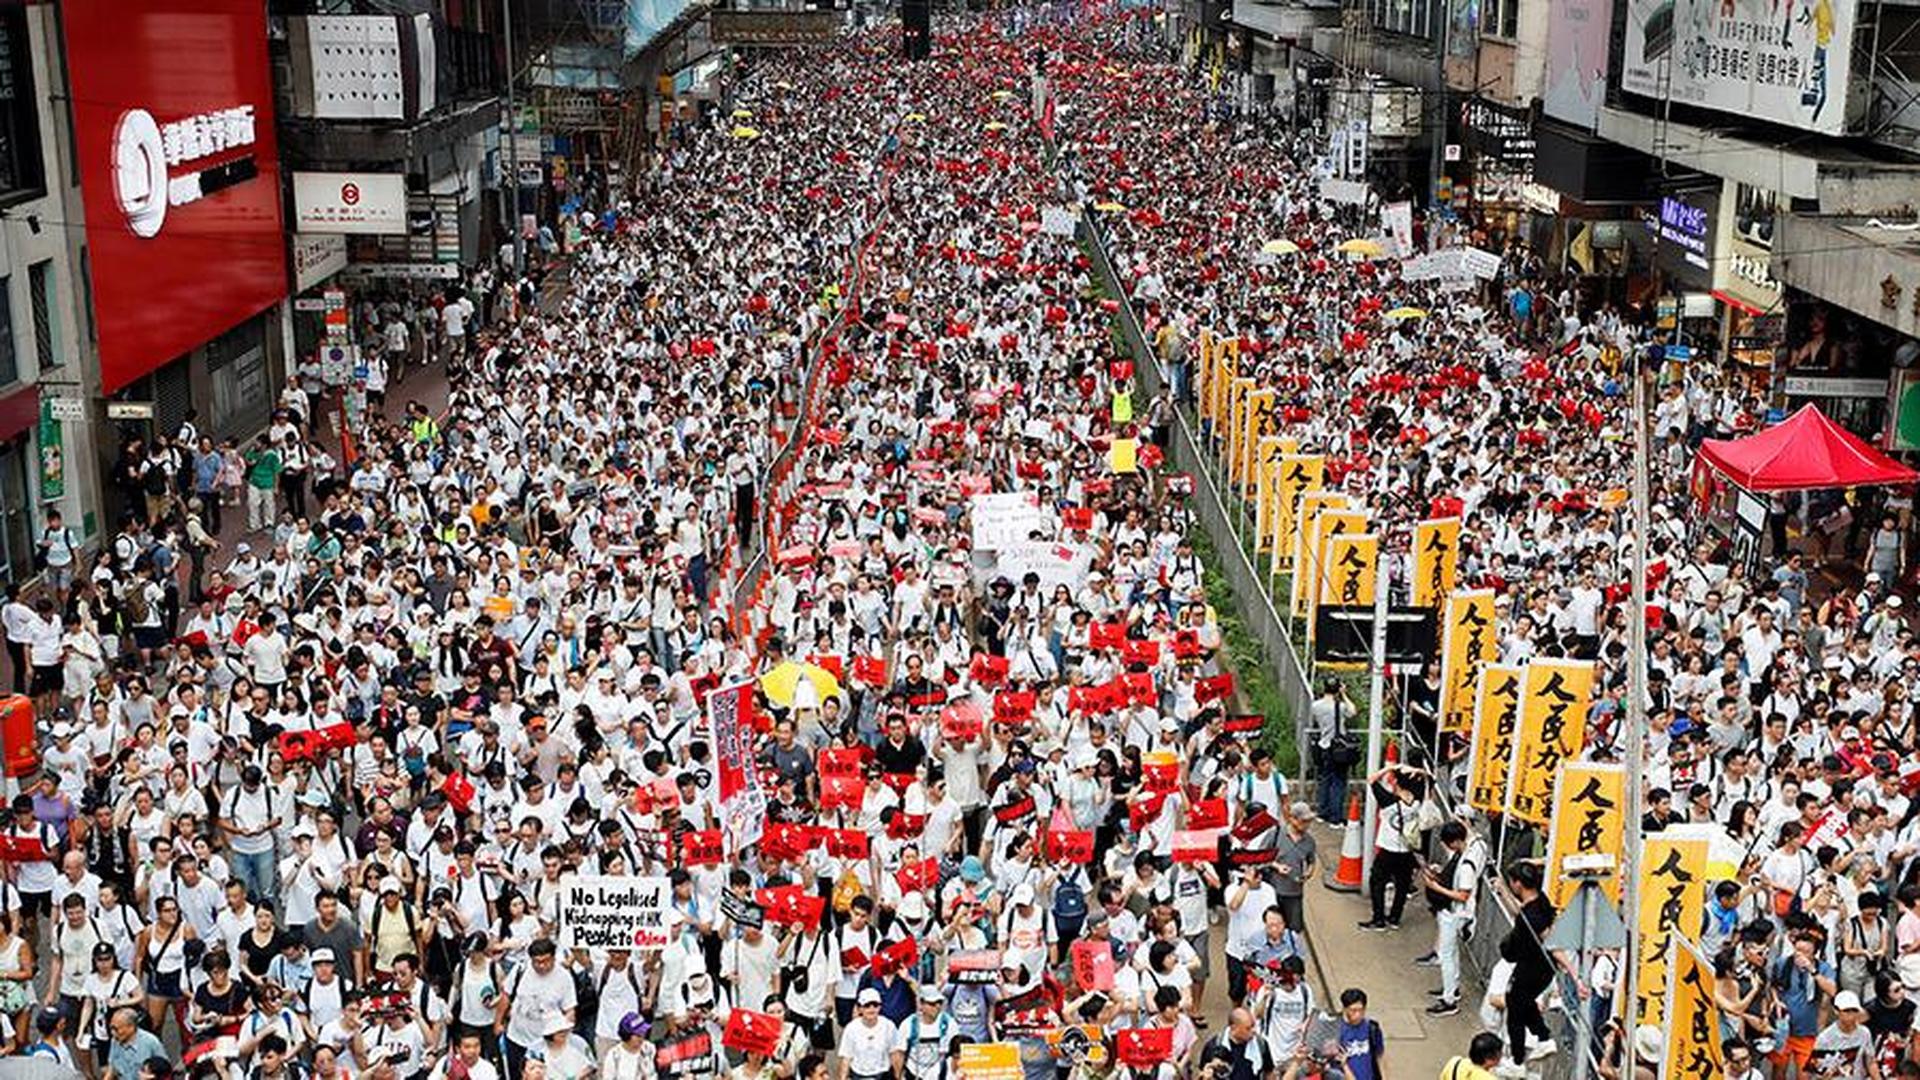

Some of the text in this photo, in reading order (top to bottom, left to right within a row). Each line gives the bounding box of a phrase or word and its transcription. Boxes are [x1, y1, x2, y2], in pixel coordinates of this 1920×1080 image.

[571, 886, 660, 909] No Legalised
[565, 907, 634, 931] Kidnapping
[646, 911, 663, 926] HK
[573, 926, 667, 946] People to China
